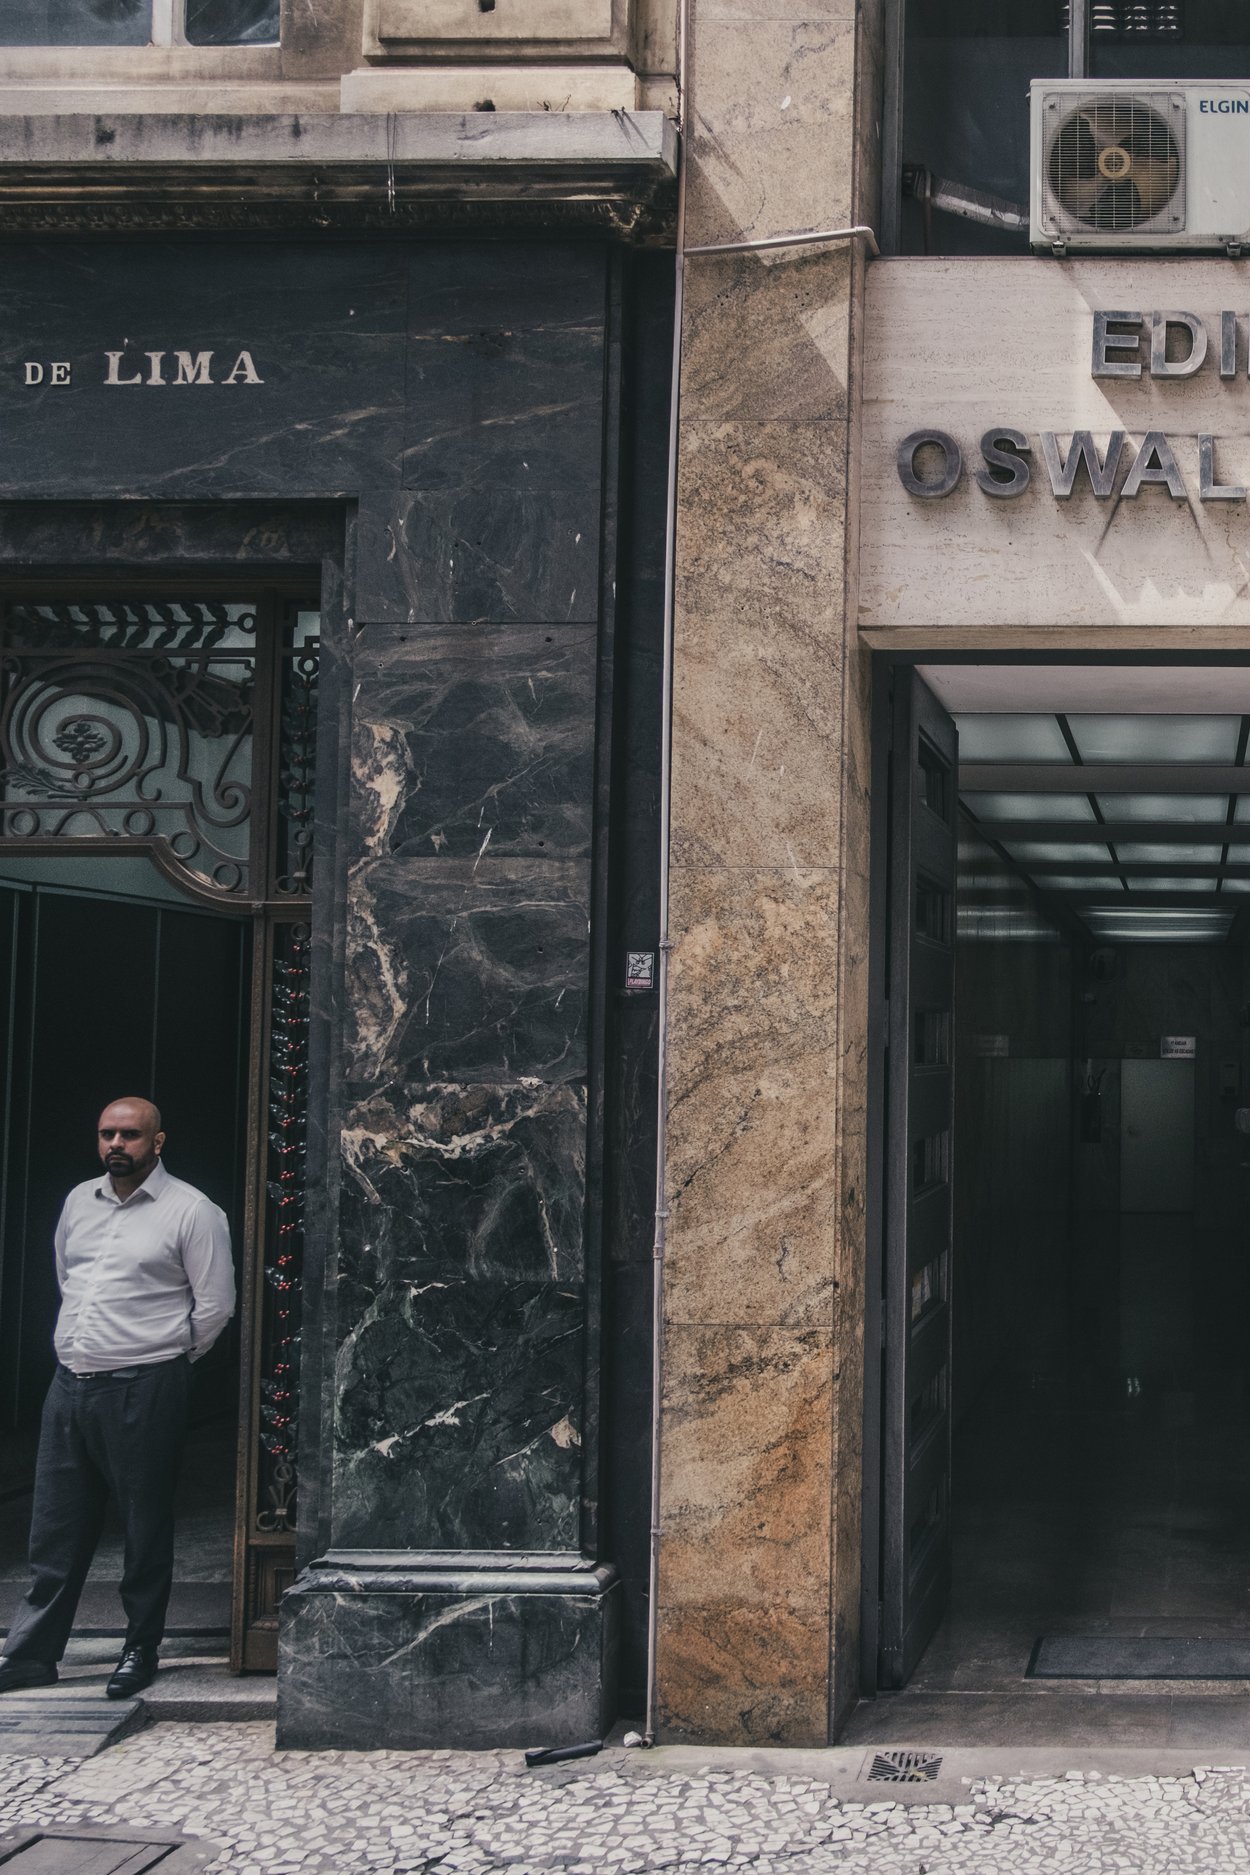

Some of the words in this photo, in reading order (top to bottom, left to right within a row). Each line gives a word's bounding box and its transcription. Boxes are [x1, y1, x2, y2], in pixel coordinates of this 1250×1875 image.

[1200, 100, 1248, 113] ELGIN
[24, 362, 71, 386] DE
[103, 350, 265, 385] LIMA
